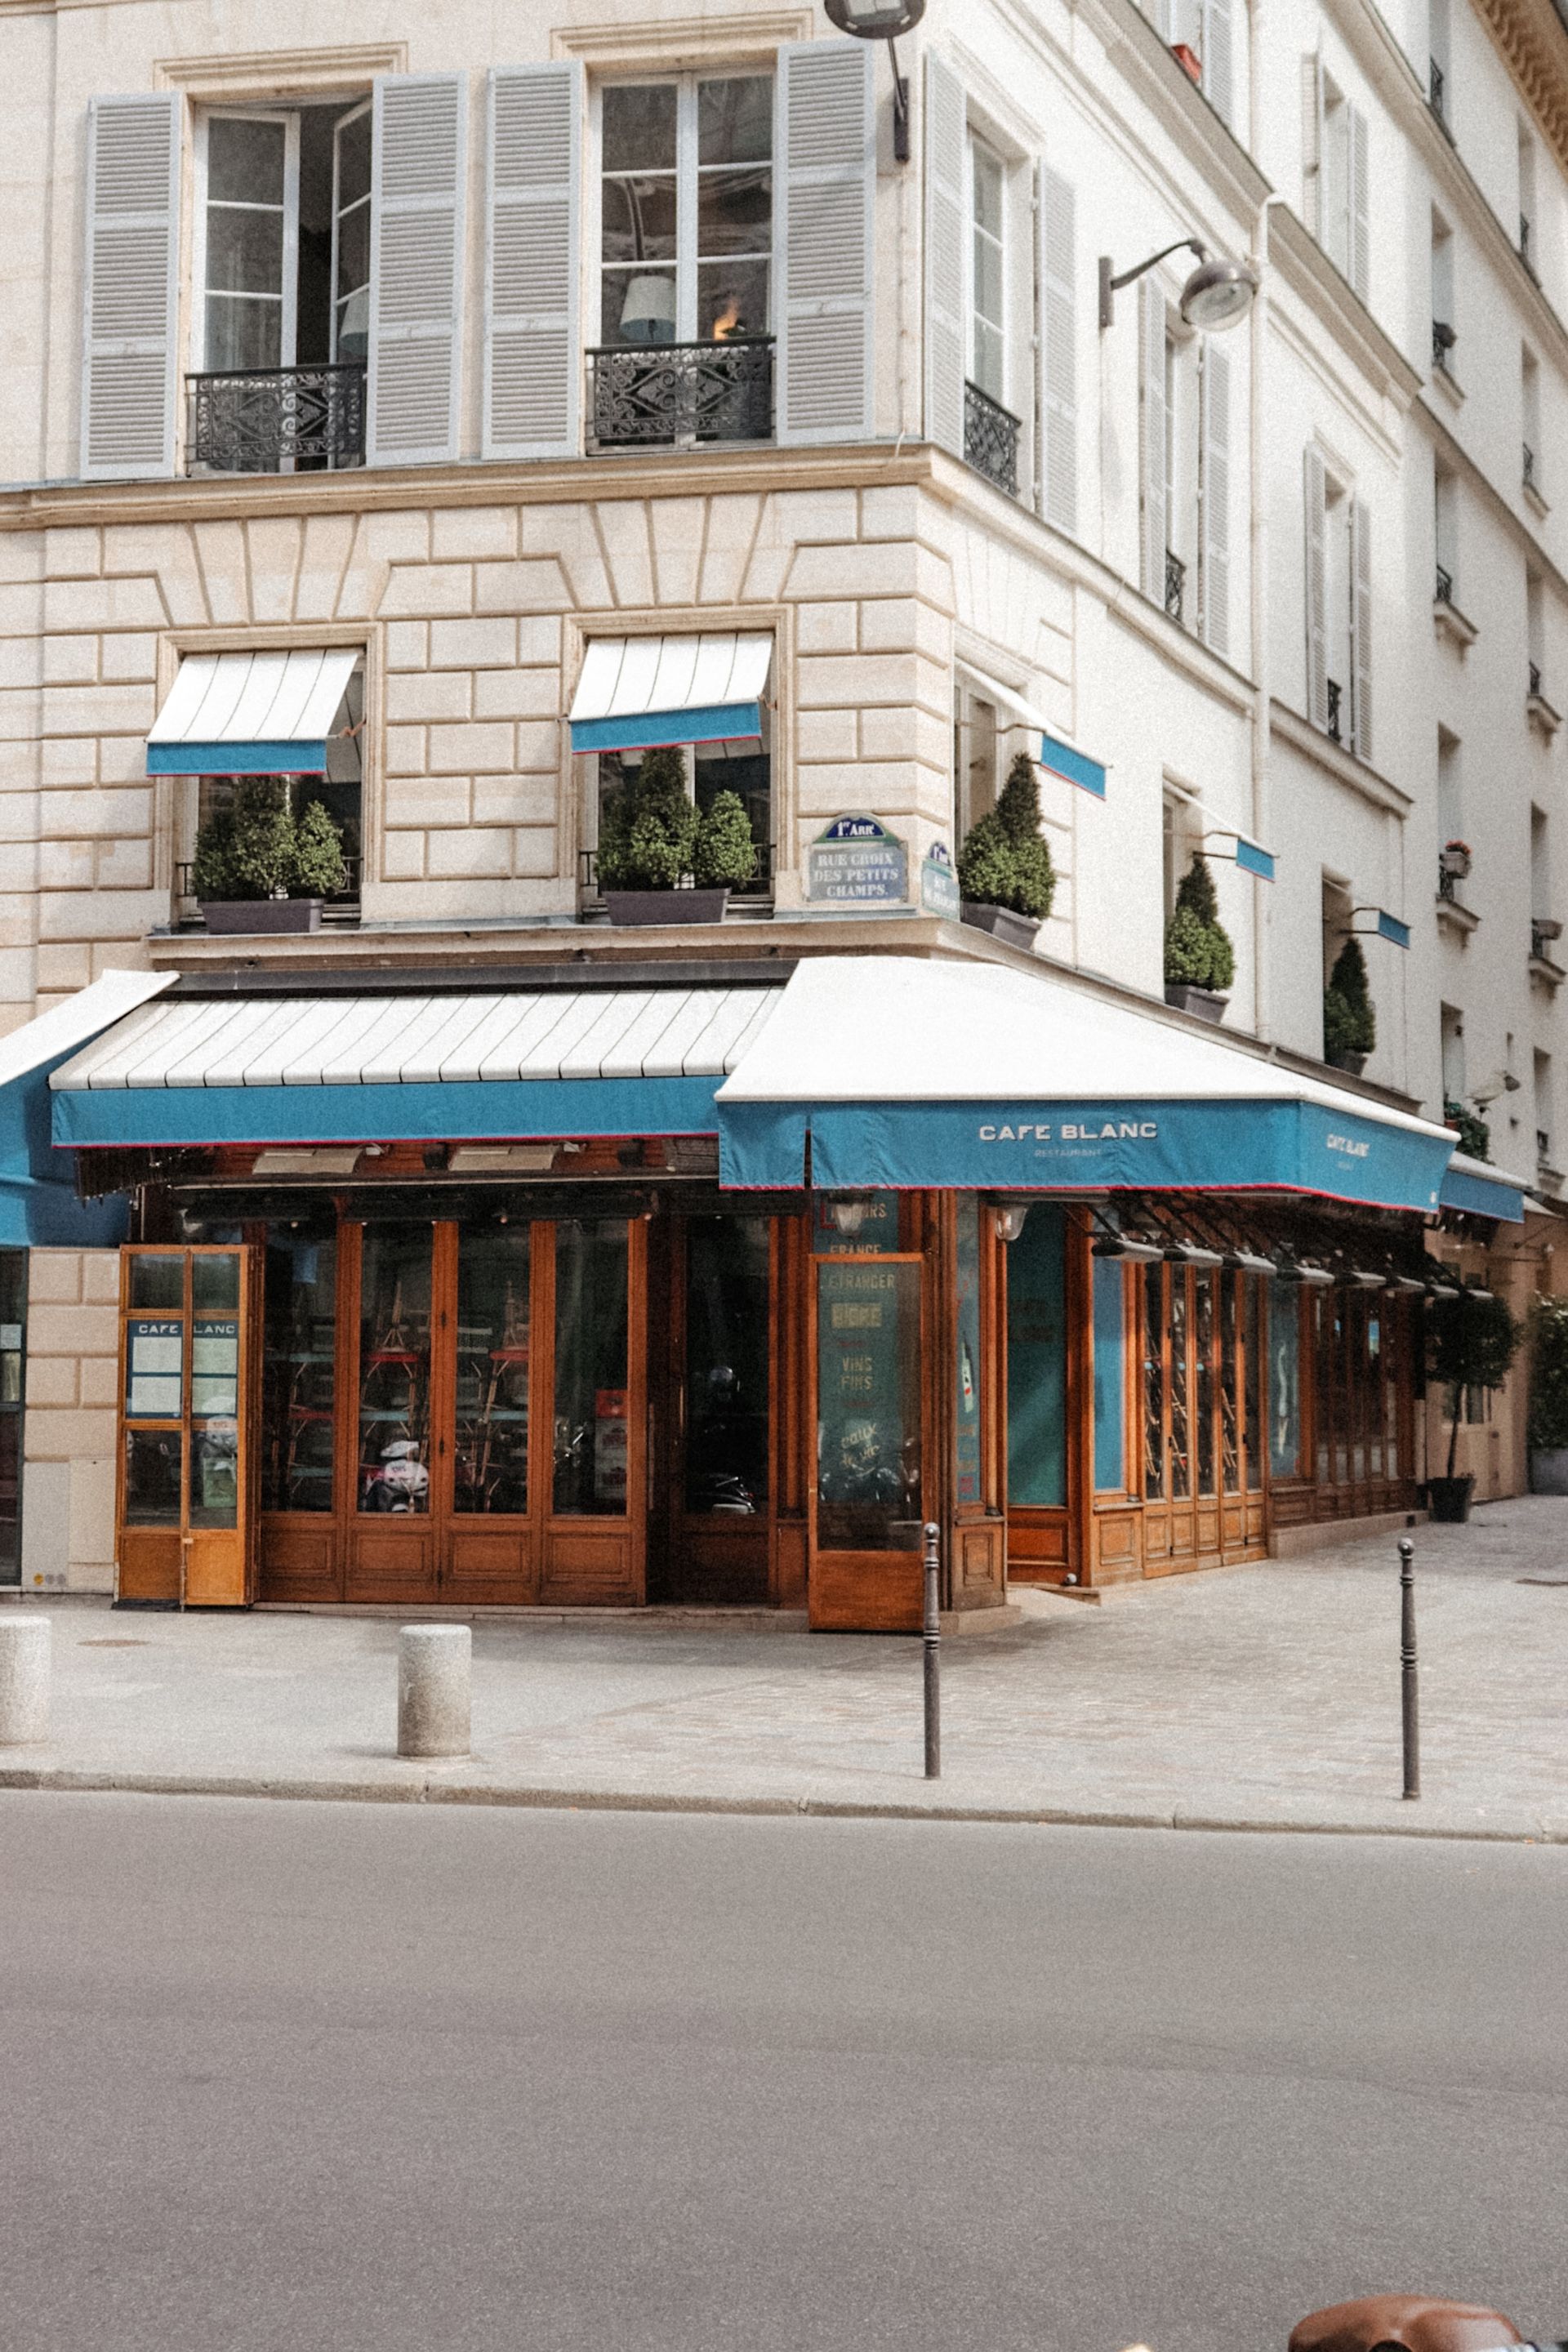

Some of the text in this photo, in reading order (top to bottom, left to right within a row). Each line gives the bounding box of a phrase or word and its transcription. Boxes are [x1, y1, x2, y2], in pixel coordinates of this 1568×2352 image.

[818, 853, 893, 866] RUE CROIX
[814, 868, 899, 882] DES PETITS
[979, 1122, 1158, 1141] CAFE BLANC
[138, 1325, 235, 1334] CAFE LANC
[842, 1356, 873, 1372] VINS
[840, 1375, 873, 1390] FINS
